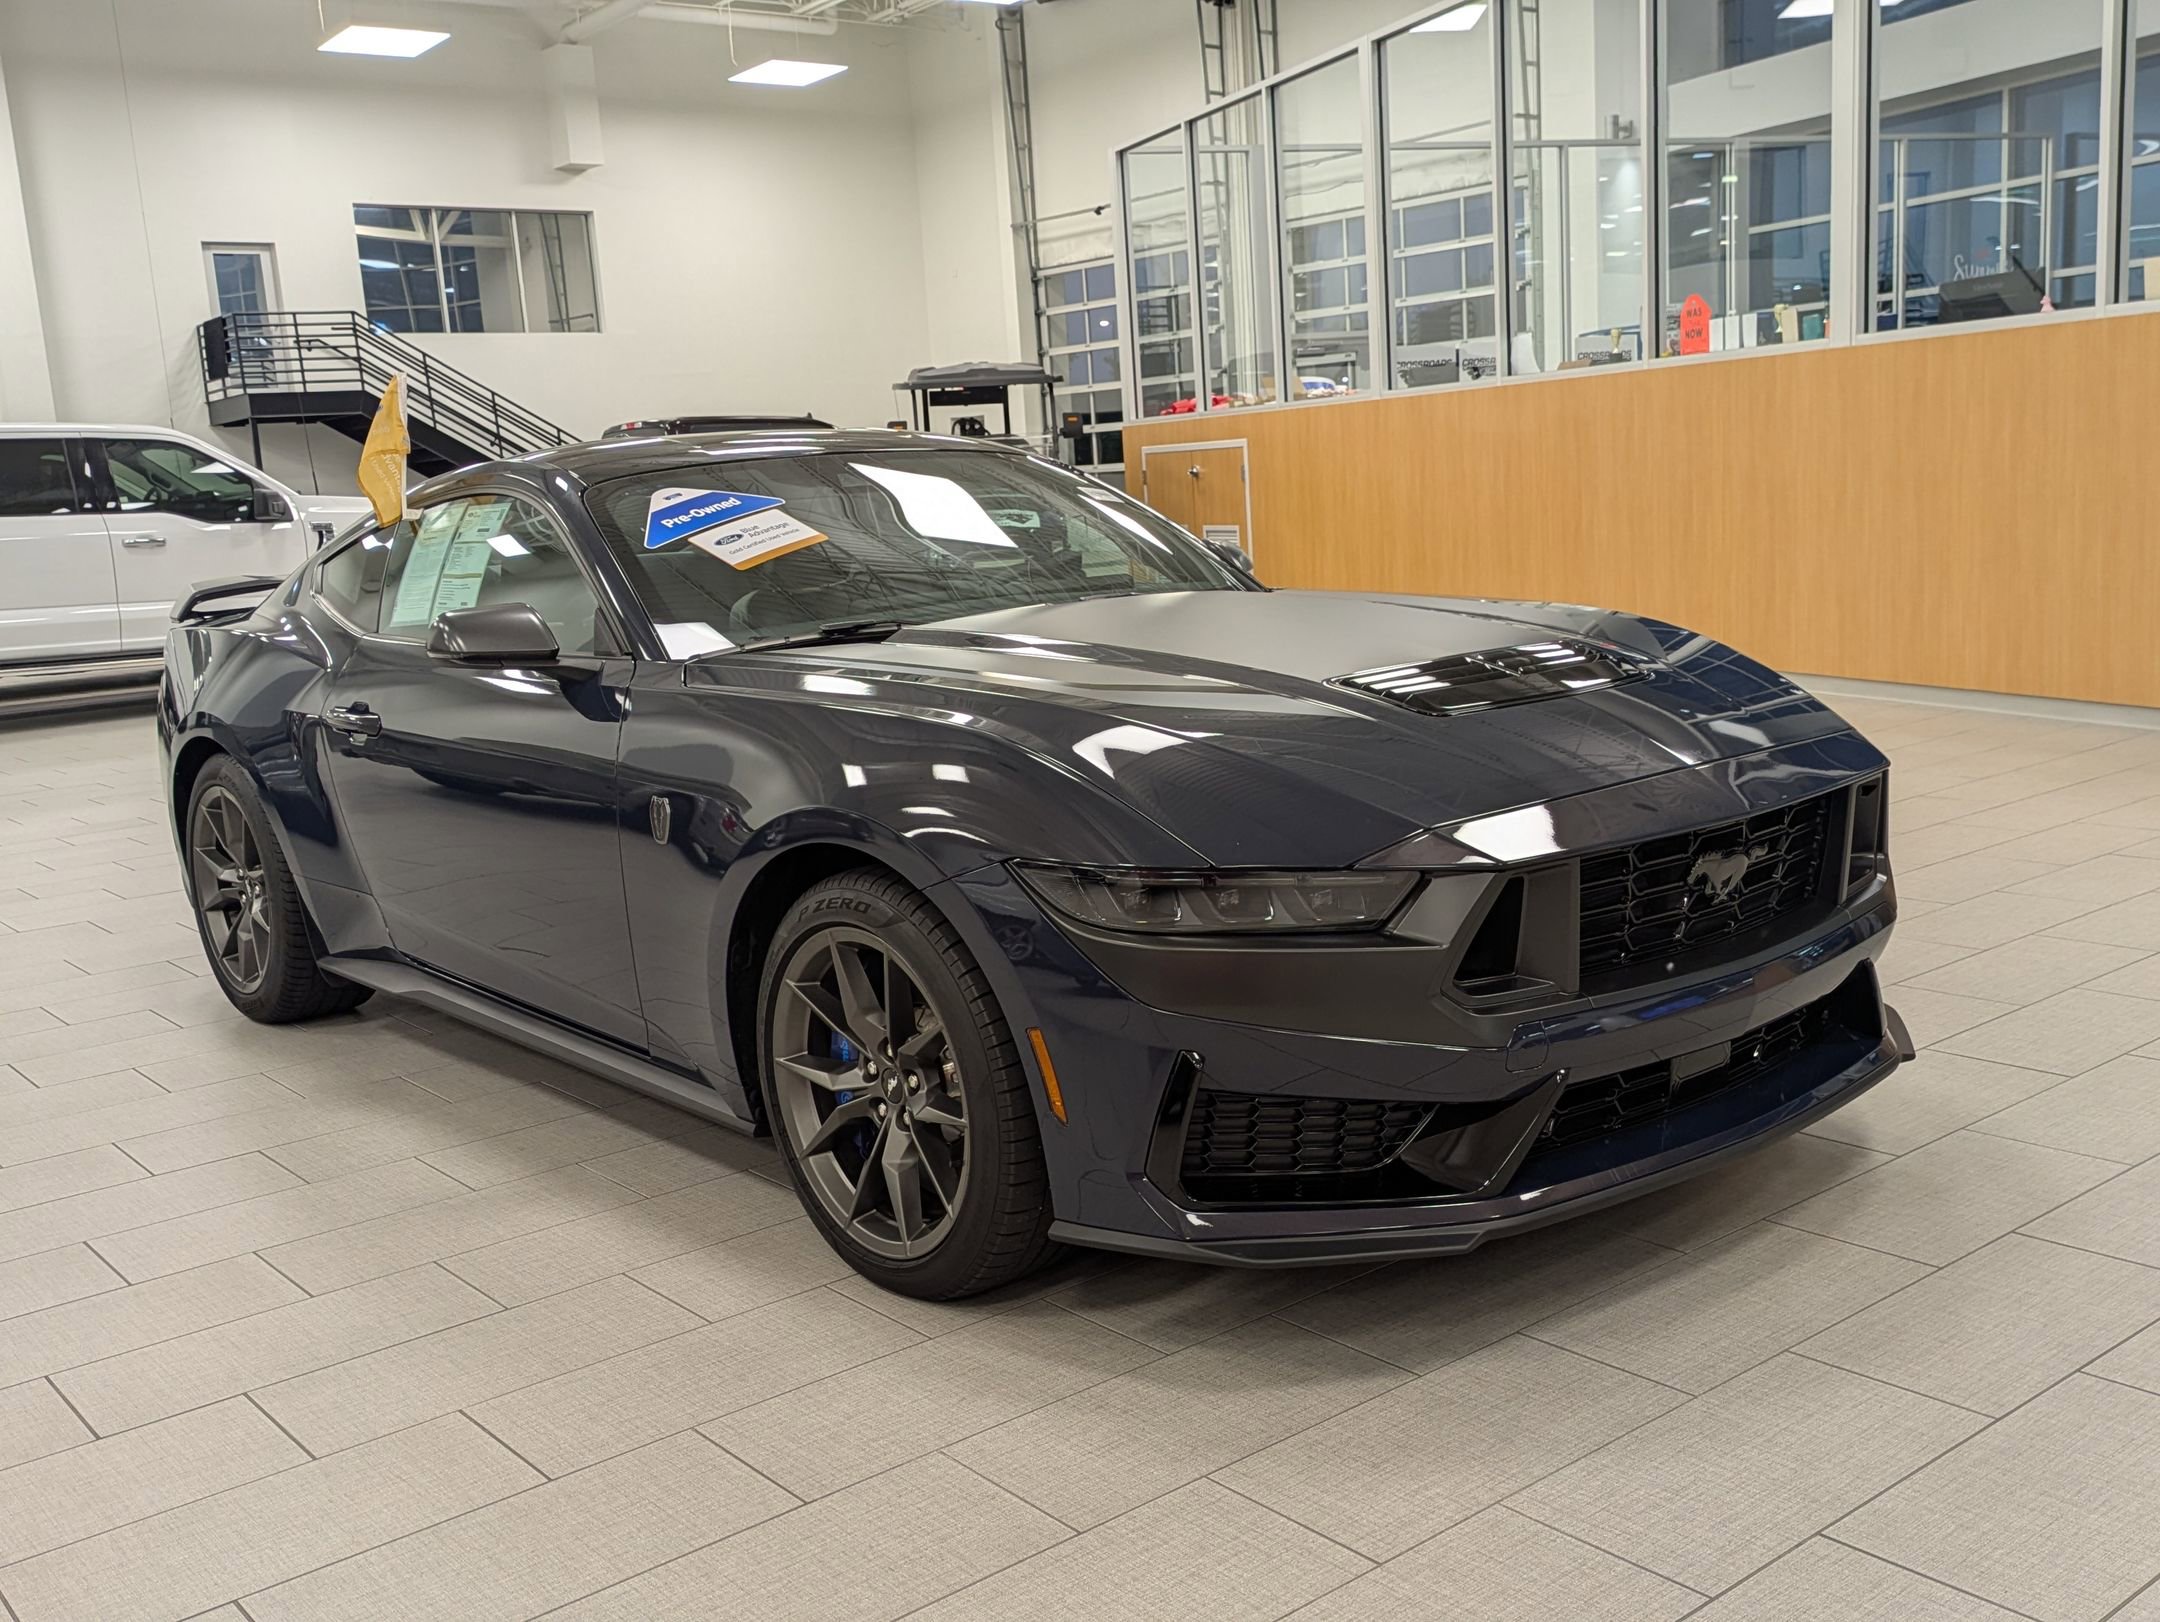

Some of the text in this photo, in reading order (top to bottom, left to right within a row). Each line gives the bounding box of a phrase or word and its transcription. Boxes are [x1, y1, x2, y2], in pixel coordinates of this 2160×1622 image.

[1686, 306, 1703, 318] WAS
[1685, 328, 1704, 339] NOW
[1577, 350, 1632, 361] CROSSRDS
[661, 497, 743, 529] Pre-Owned
[740, 525, 760, 534] Blue
[748, 522, 790, 538] Advantage
[798, 896, 872, 923] P ZERO
